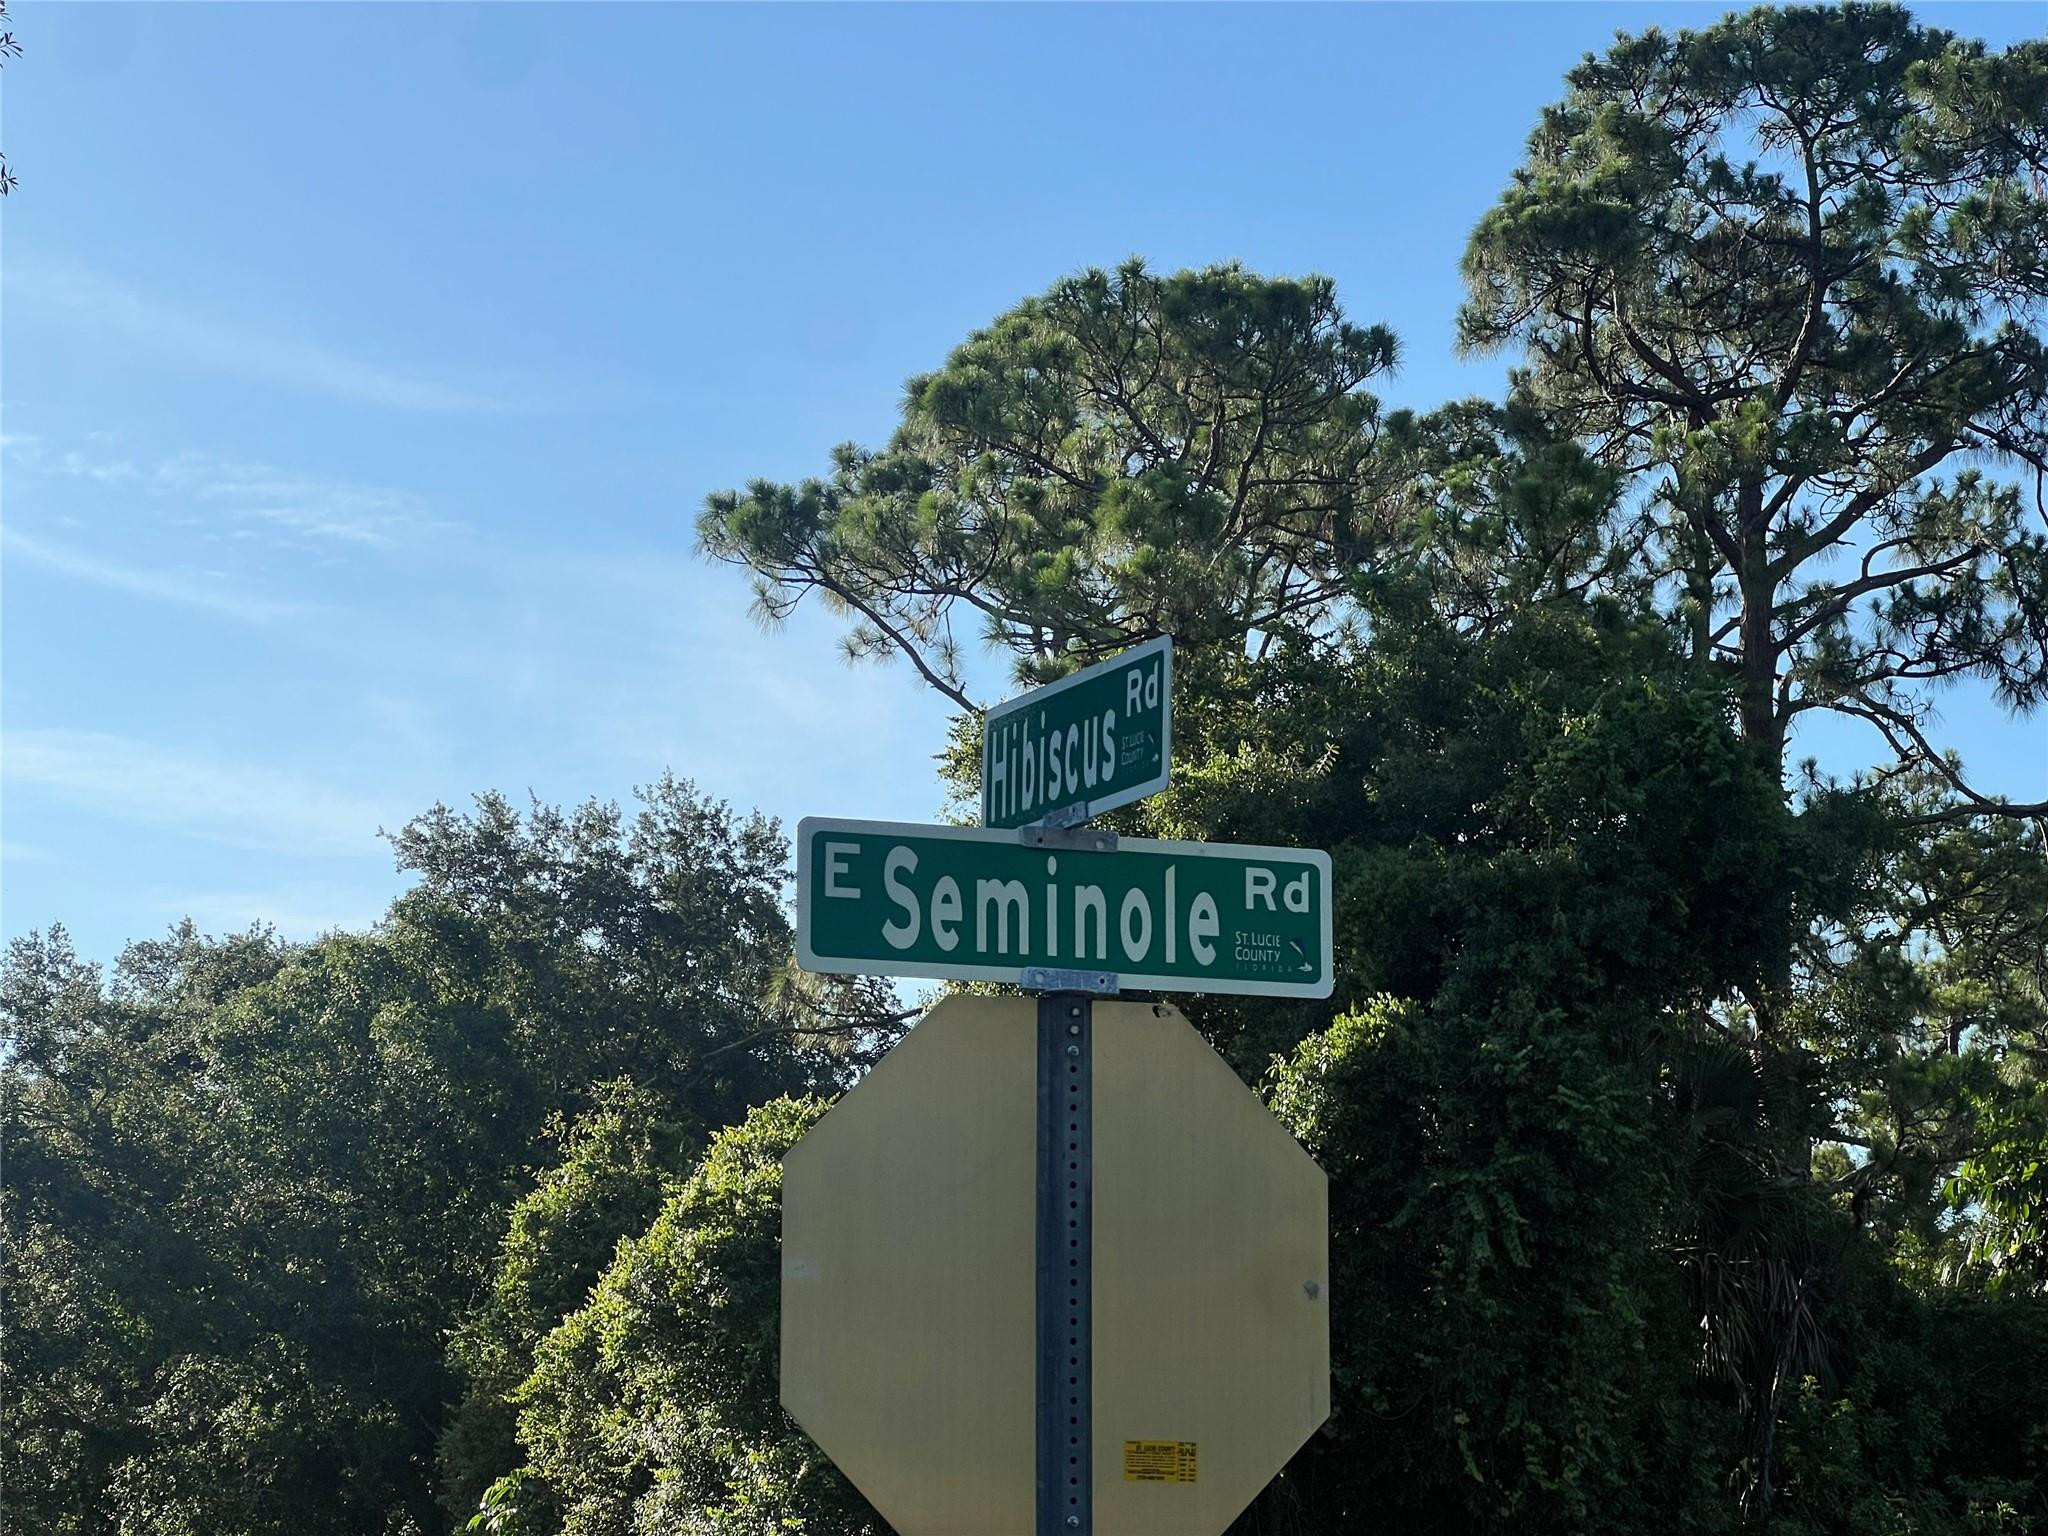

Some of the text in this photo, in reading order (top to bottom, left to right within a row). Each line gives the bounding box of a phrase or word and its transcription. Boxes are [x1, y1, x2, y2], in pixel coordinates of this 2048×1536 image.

[991, 660, 1159, 823] Hibiscus Rd
[824, 842, 1310, 967] E Seminole Rd
[1251, 932, 1281, 947] LUCIE
[1235, 946, 1281, 962] COUNTY
